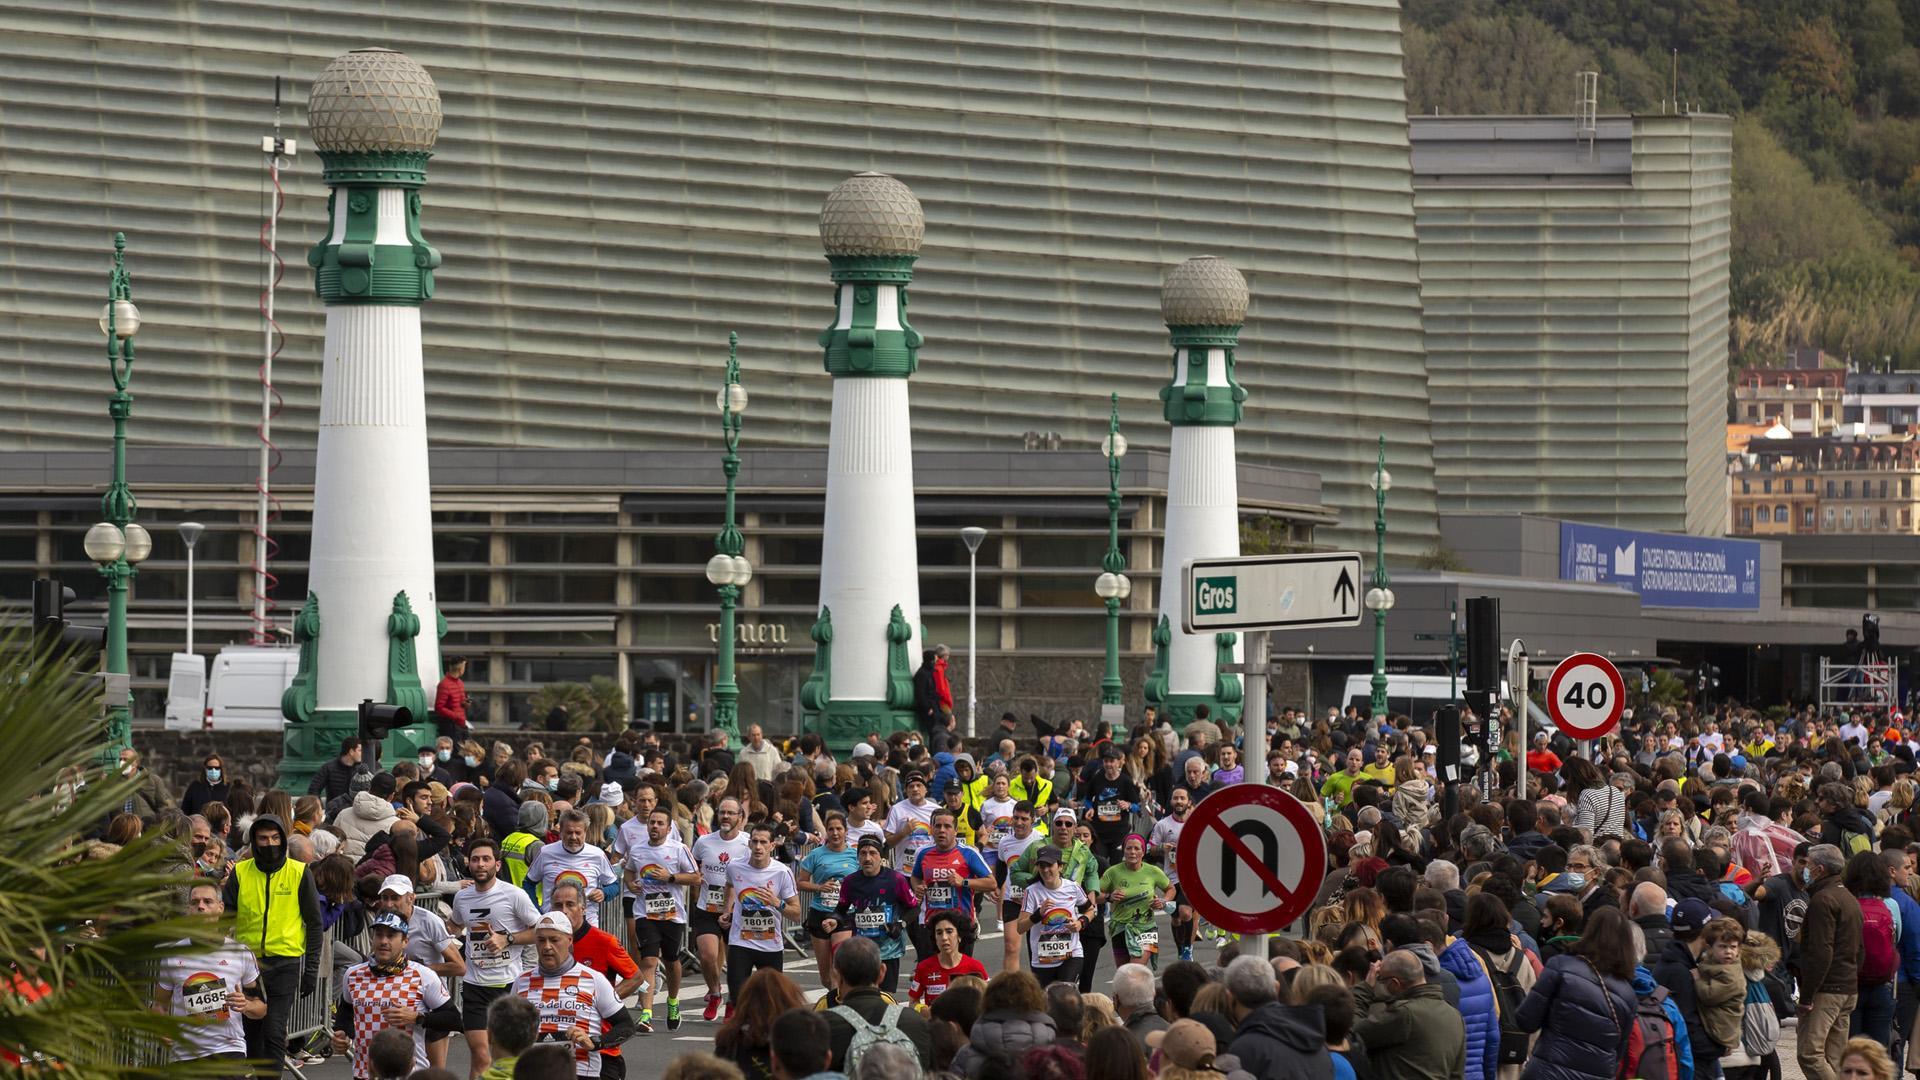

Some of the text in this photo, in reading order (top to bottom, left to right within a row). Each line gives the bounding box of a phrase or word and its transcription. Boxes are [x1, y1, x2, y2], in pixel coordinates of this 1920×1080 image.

[1199, 582, 1234, 610] Gros
[1564, 682, 1607, 710] 40
[743, 918, 774, 926] 18016
[856, 914, 884, 923] 13032
[1040, 942, 1070, 951] 15081
[187, 991, 227, 1007] 14685
[546, 1001, 562, 1009] del
[564, 1001, 586, 1010] Clot
